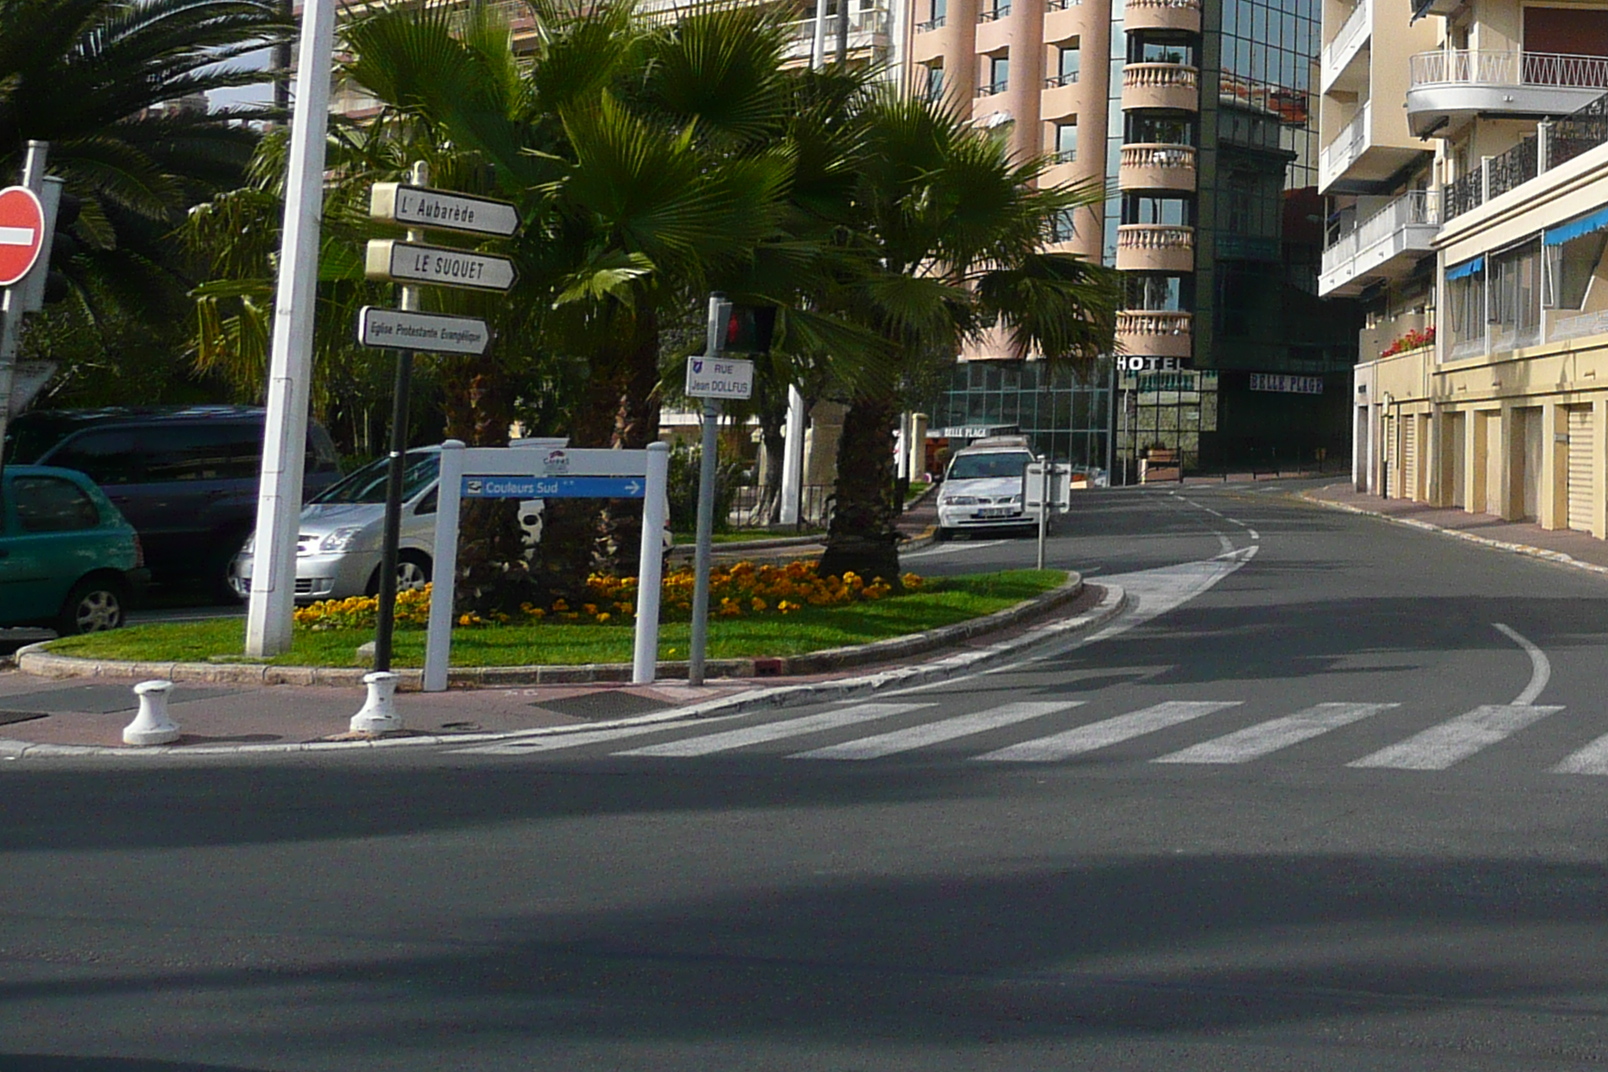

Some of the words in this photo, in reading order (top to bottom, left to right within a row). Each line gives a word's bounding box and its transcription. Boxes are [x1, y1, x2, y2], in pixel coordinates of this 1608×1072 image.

[417, 199, 475, 223] Aubarède
[415, 254, 430, 272] LE
[435, 257, 485, 279] SUQUET
[395, 324, 438, 338] Protestante
[714, 364, 734, 375] RUE
[1116, 356, 1184, 371] HOTEL
[692, 380, 710, 391] Jean
[711, 380, 748, 393] DOLLFUS
[1250, 373, 1285, 391] BELLE
[1290, 376, 1324, 394] PLAGE
[486, 480, 535, 494] Couleurs
[537, 480, 559, 494] Sud
